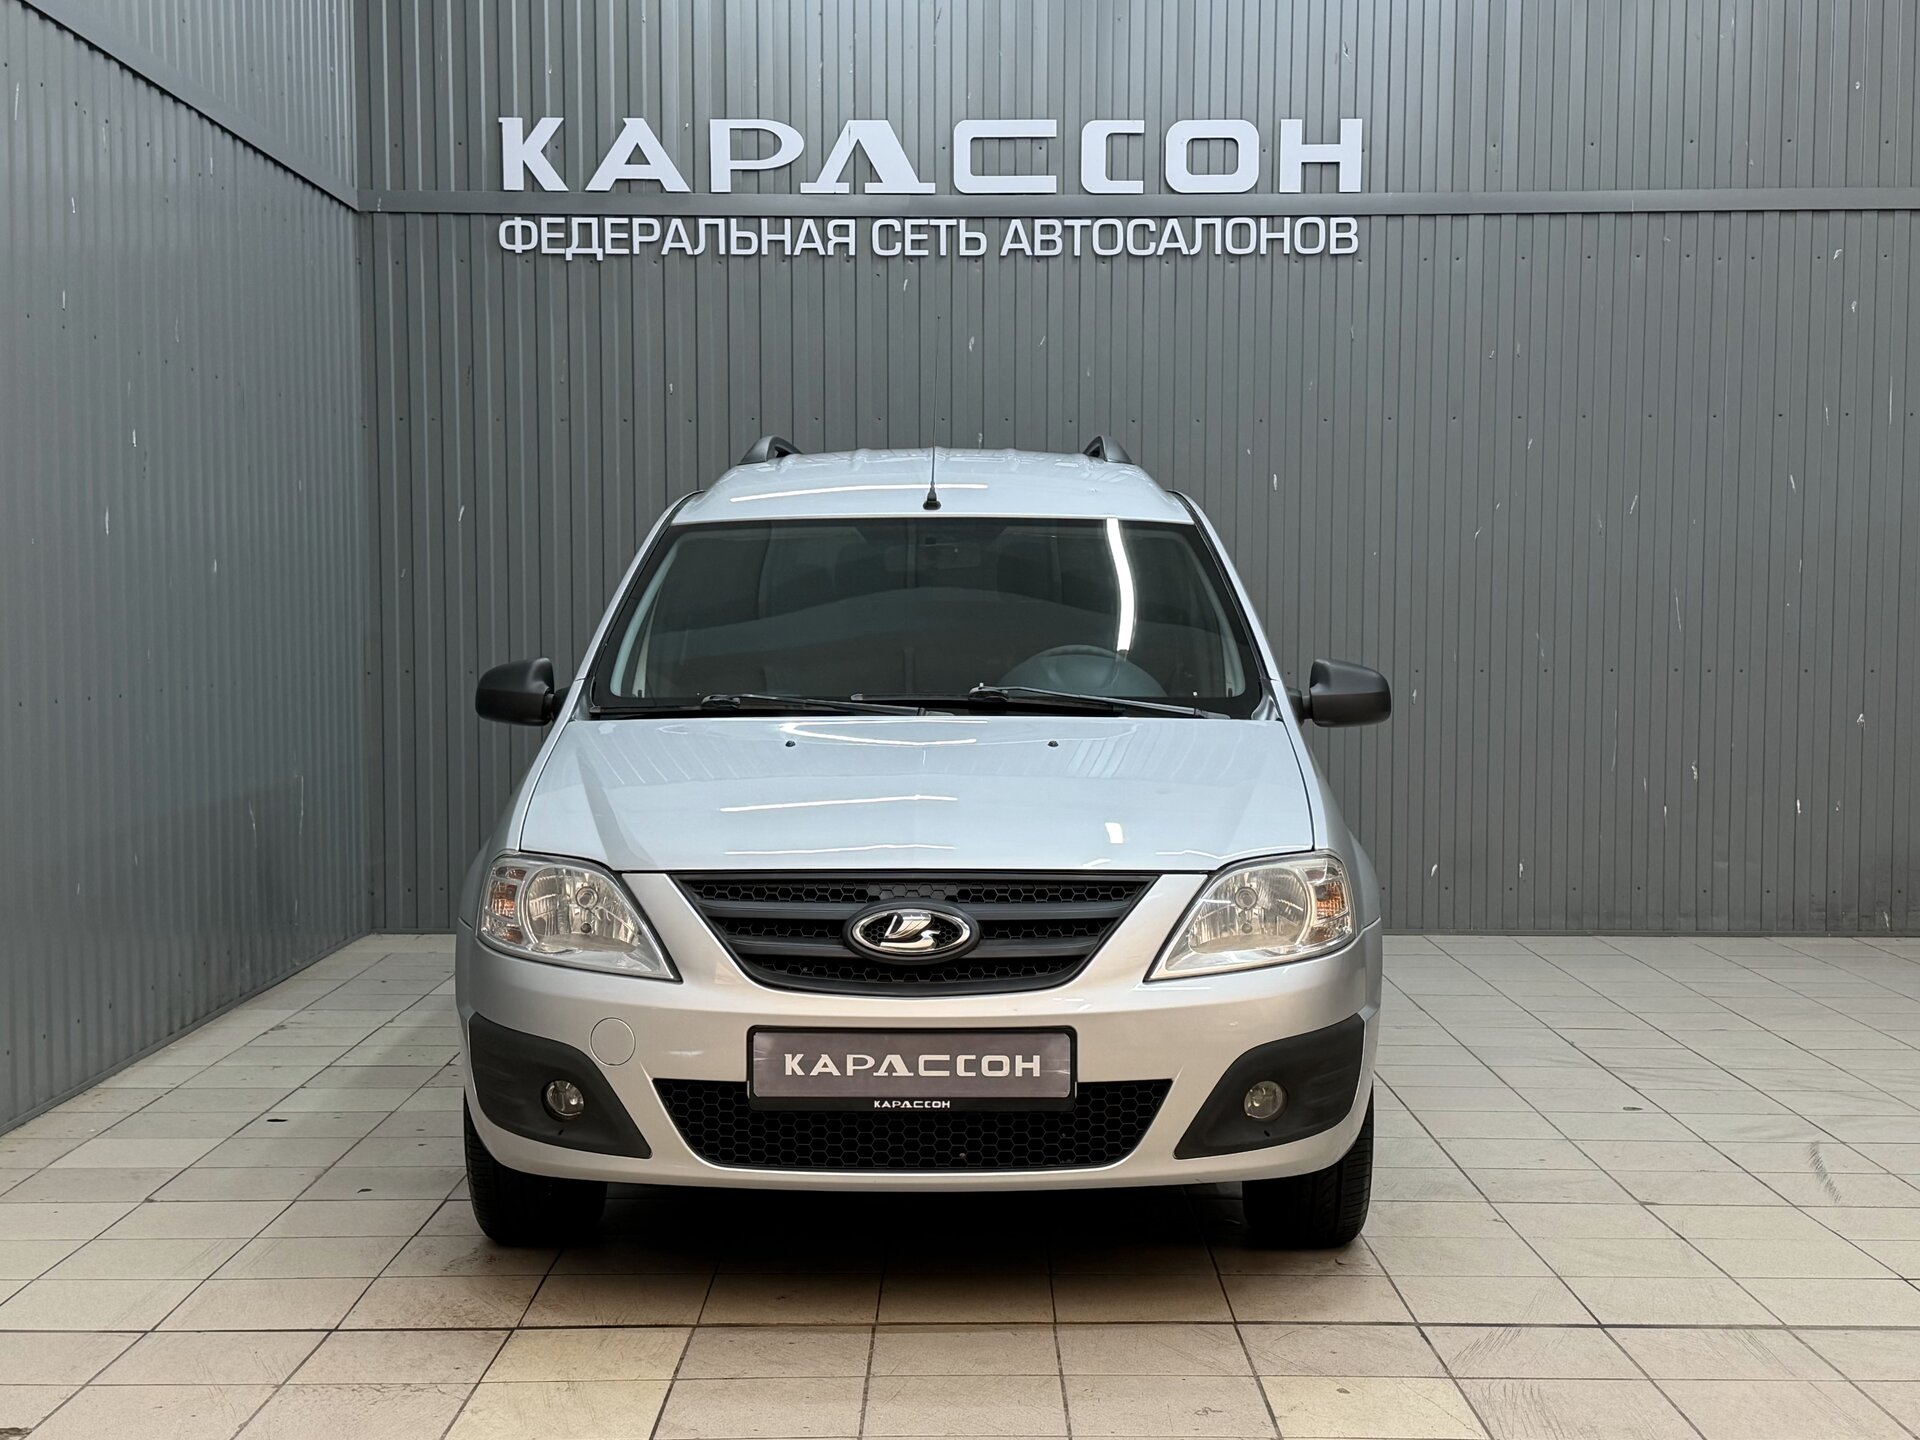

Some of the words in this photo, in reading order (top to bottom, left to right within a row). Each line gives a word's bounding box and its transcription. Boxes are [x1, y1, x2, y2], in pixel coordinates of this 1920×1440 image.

[498, 216, 857, 261] ФЕДЕРАЛЬНАЯ
[871, 217, 988, 257] СЕТЬ
[1000, 216, 1360, 257] АВТОСАЛОНОВ
